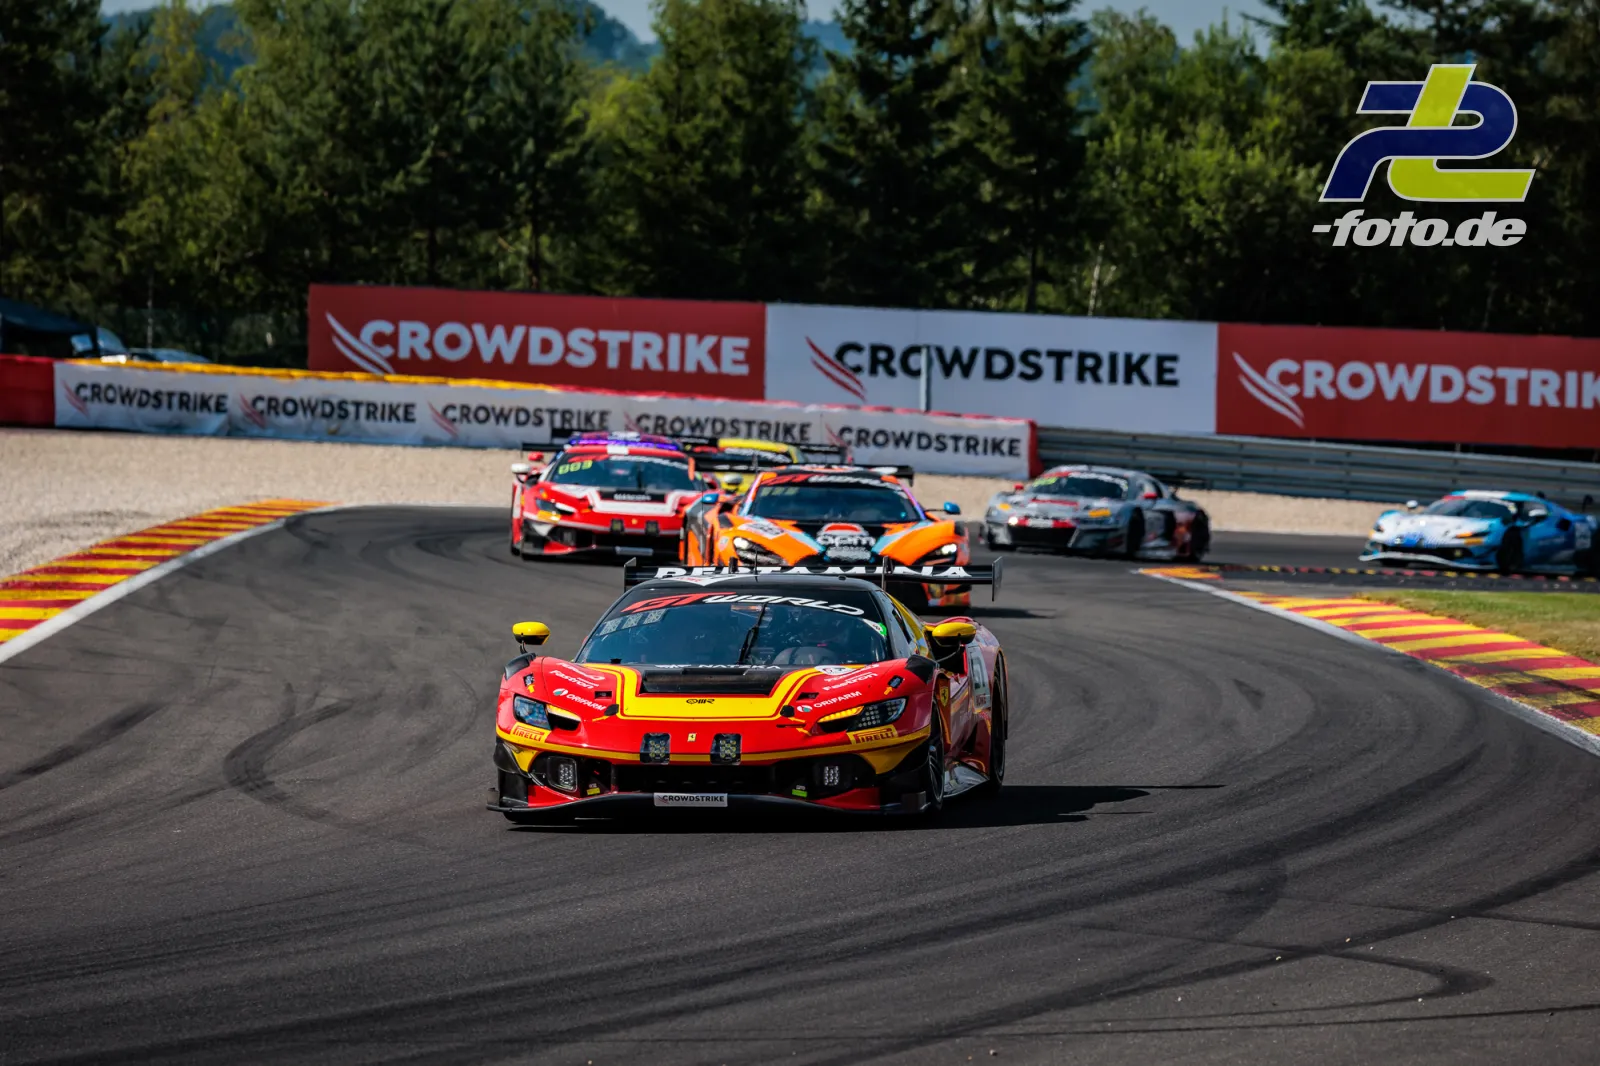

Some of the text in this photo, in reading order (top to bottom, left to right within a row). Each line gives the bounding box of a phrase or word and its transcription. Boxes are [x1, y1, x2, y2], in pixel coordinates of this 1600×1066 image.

[360, 319, 749, 375] CROWDSTRIKE
[835, 342, 1179, 386] CROWDSTRIKE
[75, 382, 228, 413] CROWDSTRIKE
[1266, 358, 1600, 409] CROWDSTRIK
[249, 394, 416, 423] CROWDSTRIKE
[442, 404, 611, 431] CROWDSTRIKE
[635, 412, 812, 441] CROWDSTRIKE
[837, 425, 1021, 457] CROWDSTRIKE
[703, 595, 864, 616] WORLD
[566, 693, 606, 711] ORIFARM
[814, 691, 862, 708] ORIFARM
[513, 726, 545, 741] PIRELLI
[853, 728, 894, 743] PIRELLI
[662, 795, 725, 803] CROWDSTRIKE
